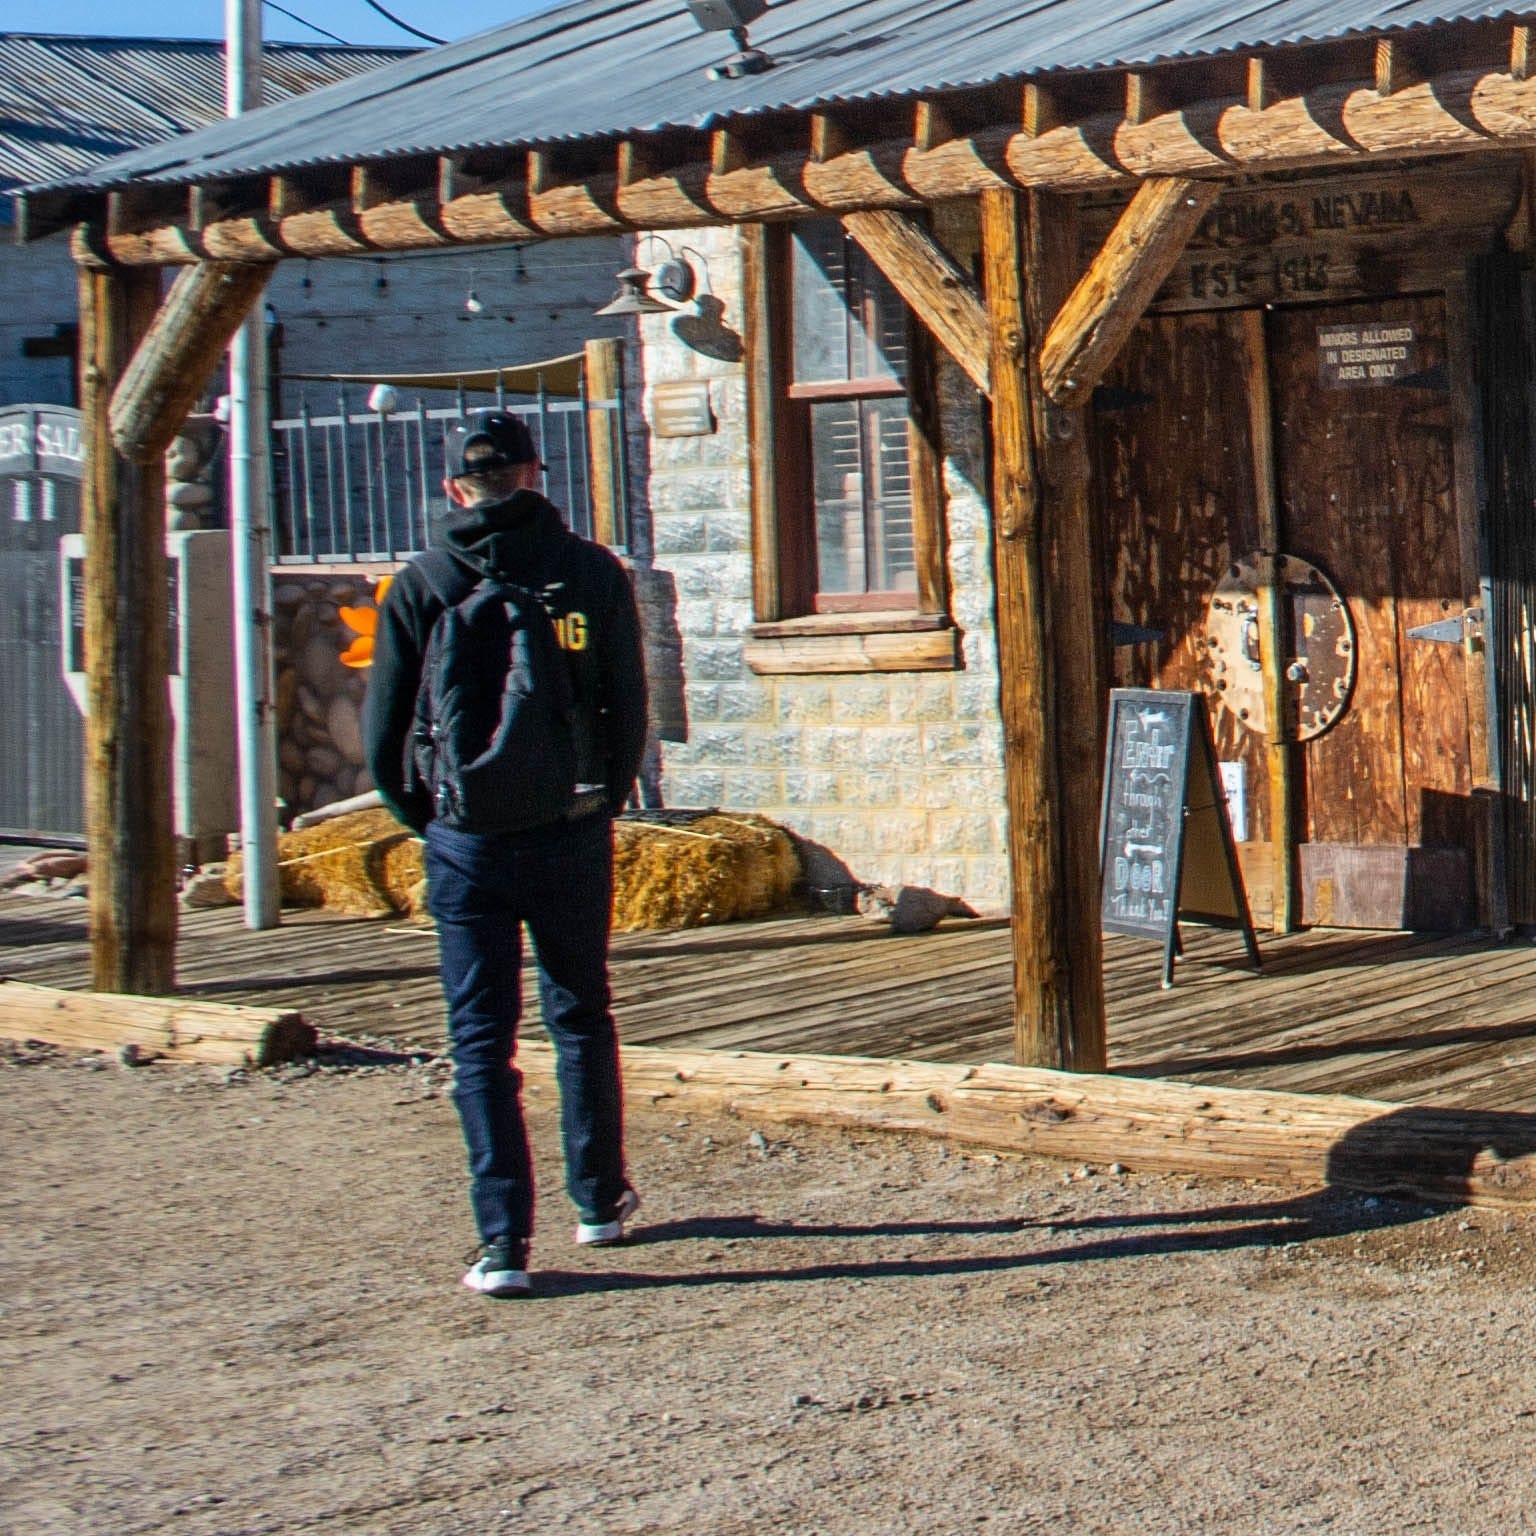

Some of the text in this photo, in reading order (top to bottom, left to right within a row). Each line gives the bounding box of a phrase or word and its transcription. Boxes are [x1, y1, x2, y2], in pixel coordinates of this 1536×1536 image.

[1320, 328, 1413, 347] MINORS ALLOWED
[1327, 346, 1407, 364] IN DESIGNATED
[1339, 363, 1396, 379] AREA ONLY
